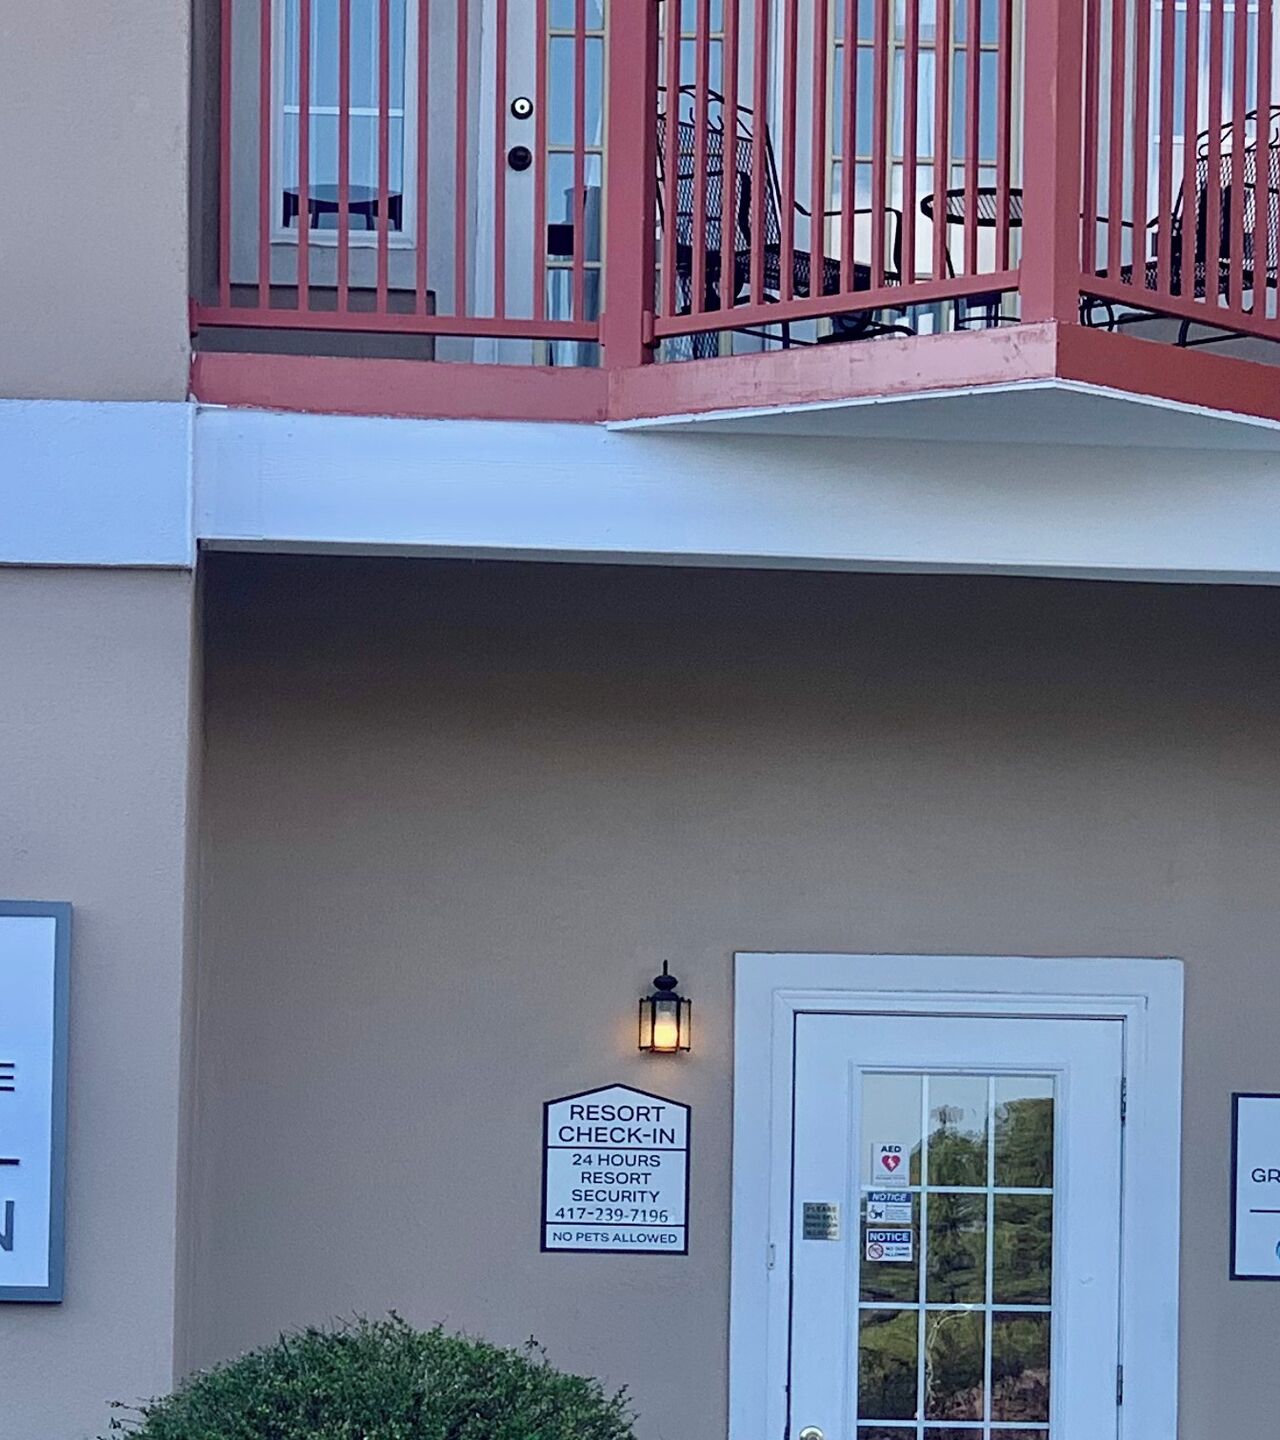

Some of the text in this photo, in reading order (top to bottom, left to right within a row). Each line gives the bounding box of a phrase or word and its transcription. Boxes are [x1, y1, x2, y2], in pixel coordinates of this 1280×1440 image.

[570, 1104, 666, 1122] RESORT
[558, 1126, 675, 1144] CHECK-IN
[881, 1145, 902, 1153] AED
[572, 1153, 661, 1167] 24 HOURS
[581, 1171, 652, 1185] RESORT
[572, 1189, 660, 1203] SECURITY
[871, 1193, 908, 1201] NOTICE
[555, 1207, 668, 1223] 417-239-7196
[552, 1232, 678, 1244] NO PETS ALLOWED
[869, 1232, 909, 1241] NOTICE
